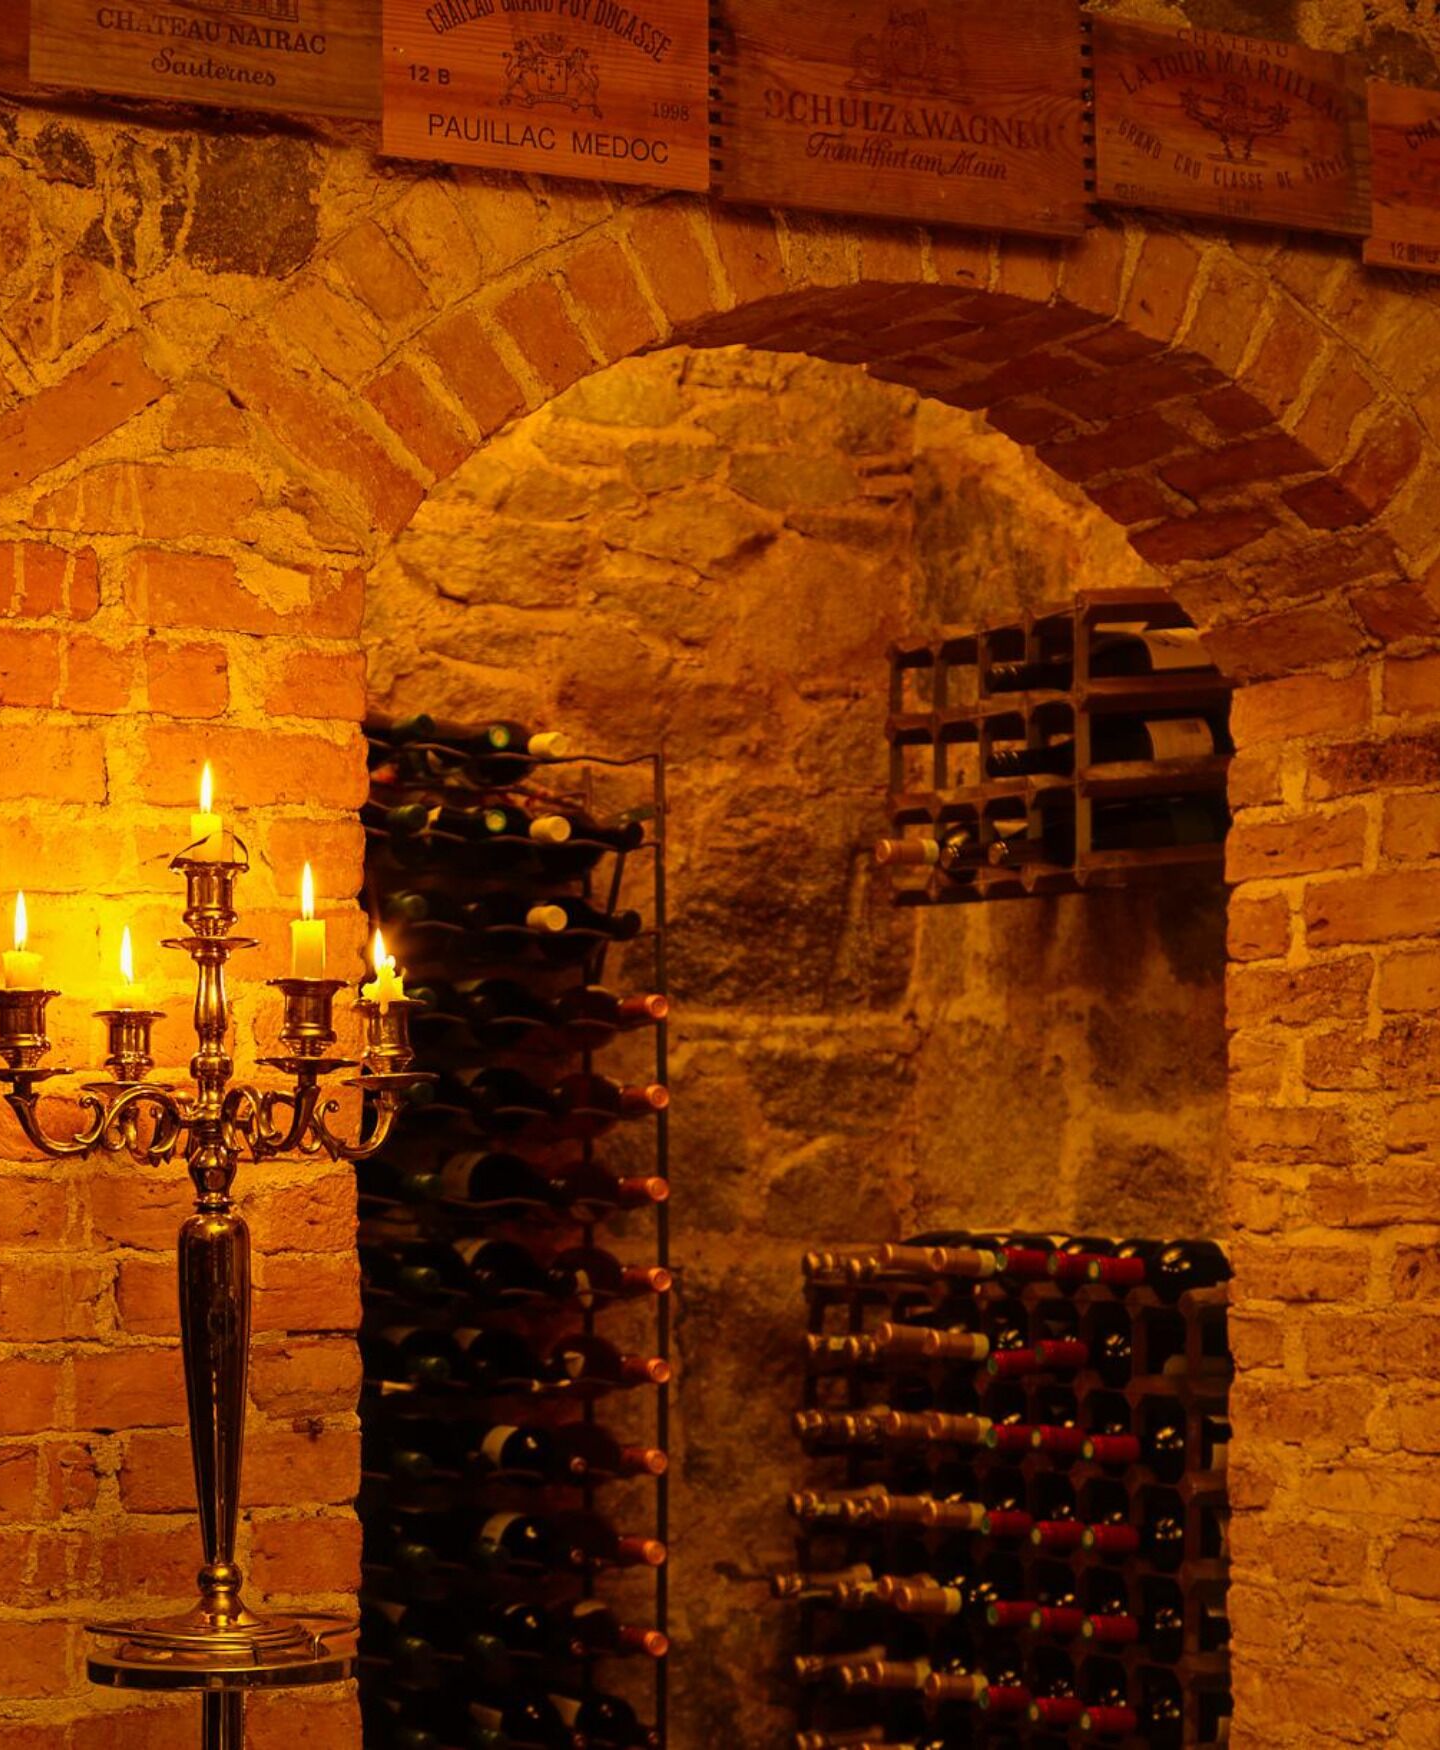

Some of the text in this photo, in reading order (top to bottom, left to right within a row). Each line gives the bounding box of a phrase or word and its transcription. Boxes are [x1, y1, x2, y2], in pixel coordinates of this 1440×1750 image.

[228, 26, 327, 55] NAIRAC
[426, 0, 495, 35] CHATEAU
[593, 0, 672, 64] DUCASSE
[150, 48, 277, 88] Sauternes
[408, 64, 451, 85] 12 B
[651, 102, 691, 122] 1998
[428, 113, 670, 165] PAUILLAC MEDOC
[1173, 153, 1202, 181] CRU
[1213, 166, 1265, 193] CLASSE
